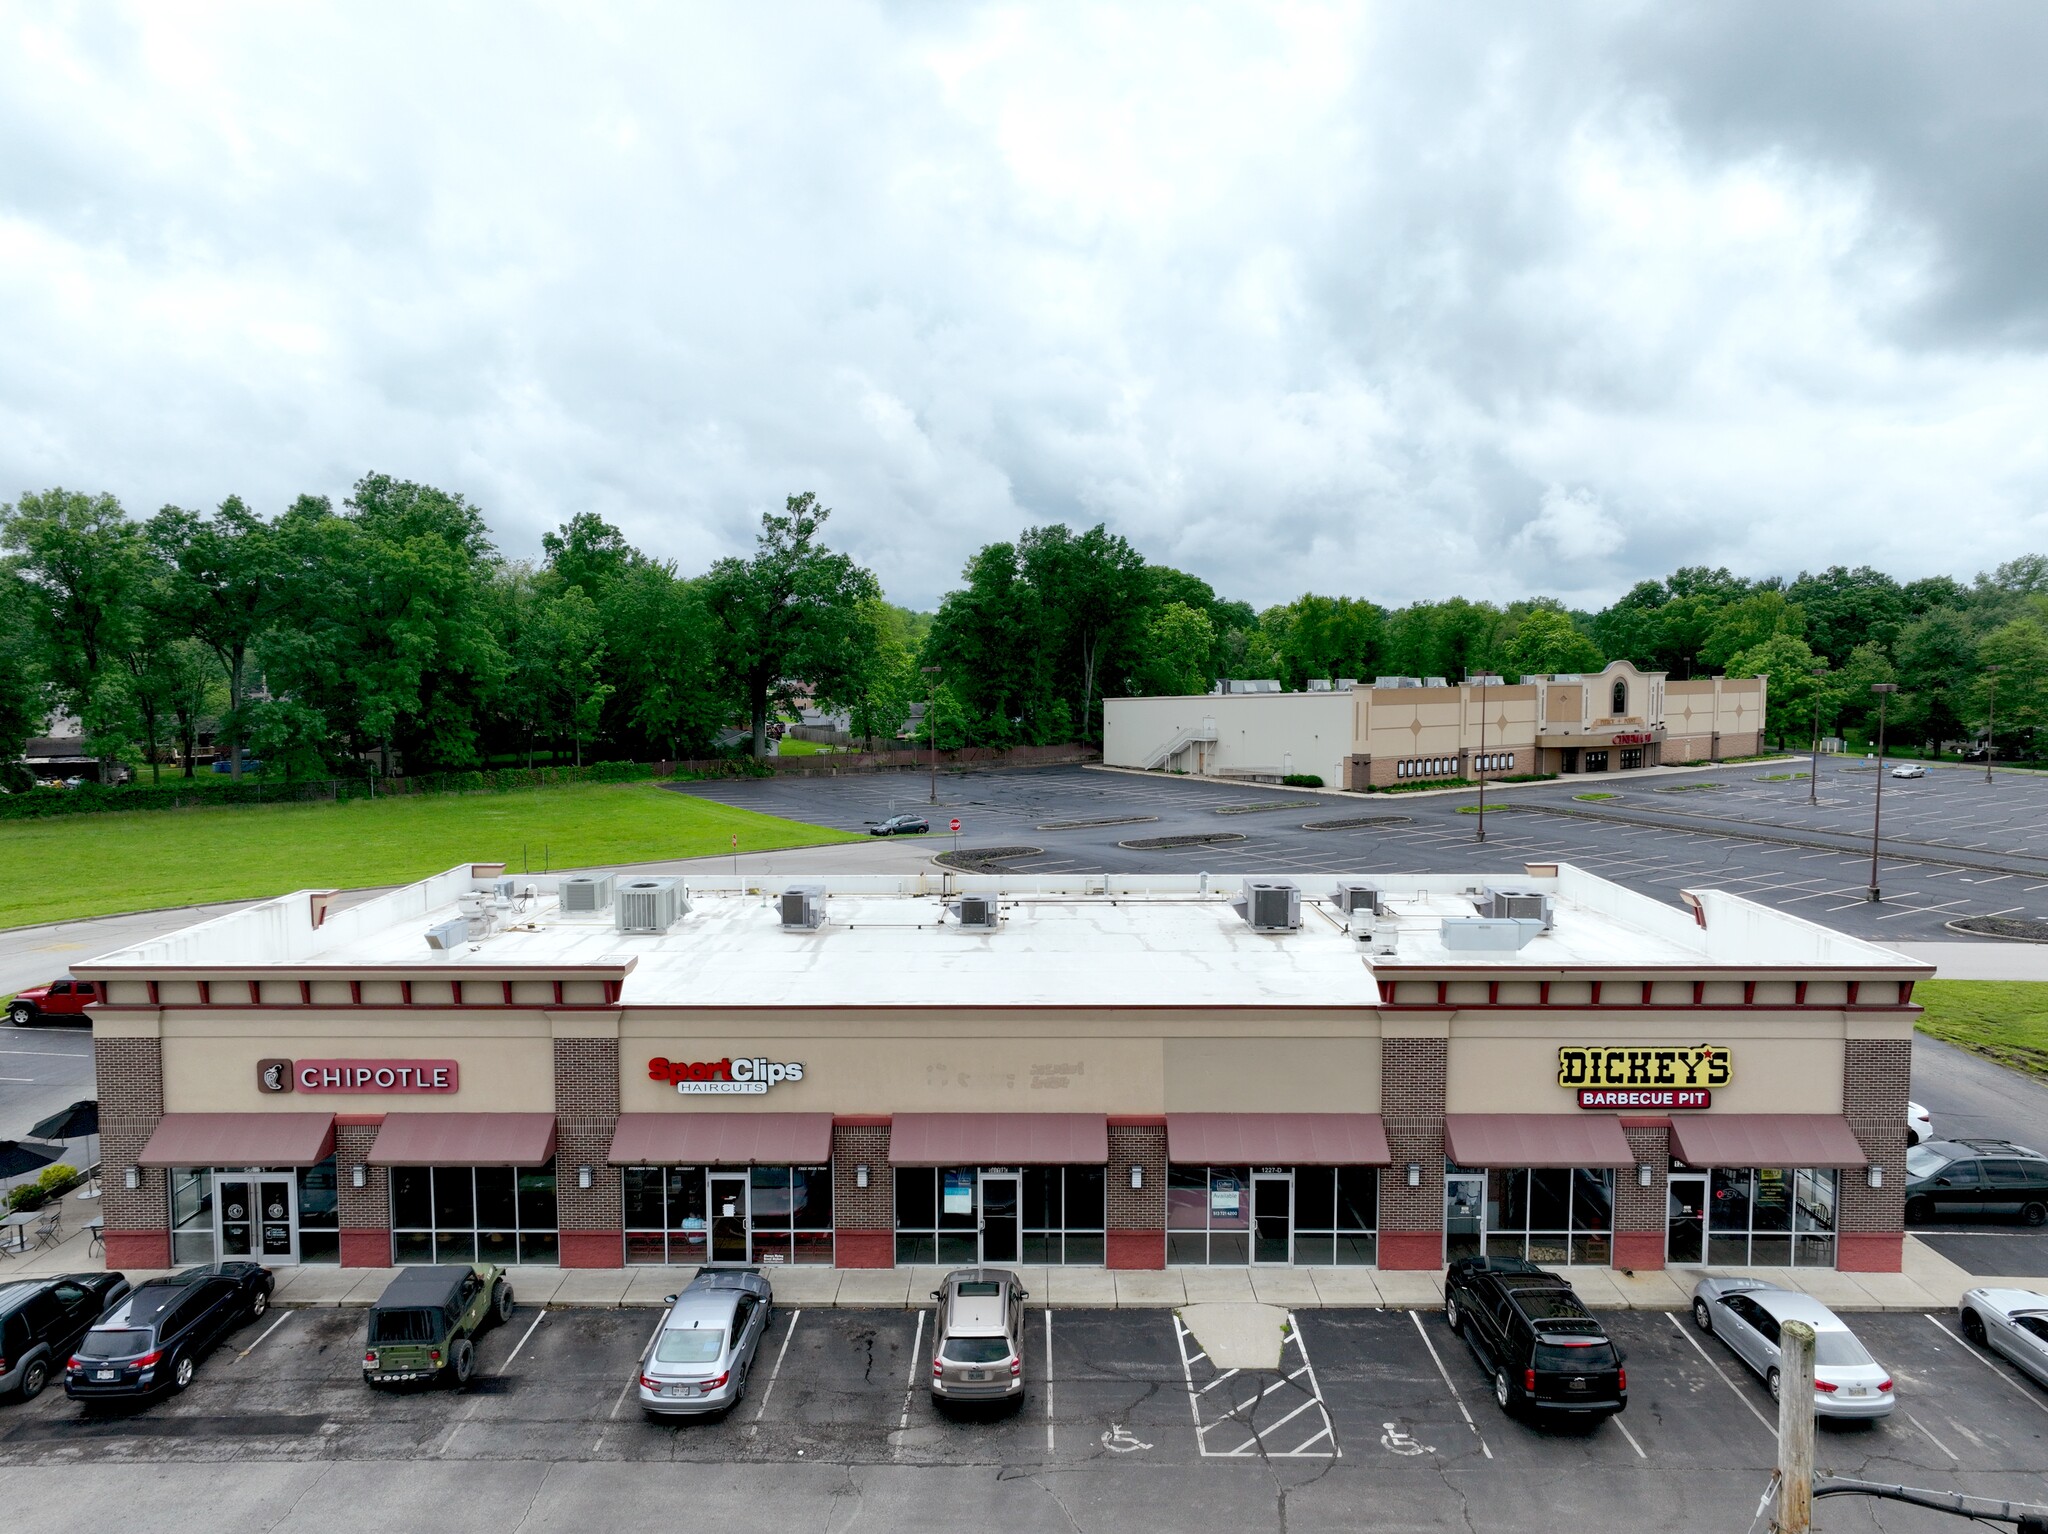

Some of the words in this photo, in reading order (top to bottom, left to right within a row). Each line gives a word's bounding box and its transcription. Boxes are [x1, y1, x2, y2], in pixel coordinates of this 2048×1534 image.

[1562, 1050, 1730, 1084] DICKEY'S
[300, 1068, 449, 1088] CHIPOTLE
[681, 1083, 764, 1092] HAIRCUTS
[1583, 1092, 1673, 1105] BARBECUE
[1678, 1092, 1705, 1105] PIT
[1716, 1190, 1738, 1199] OPEN
